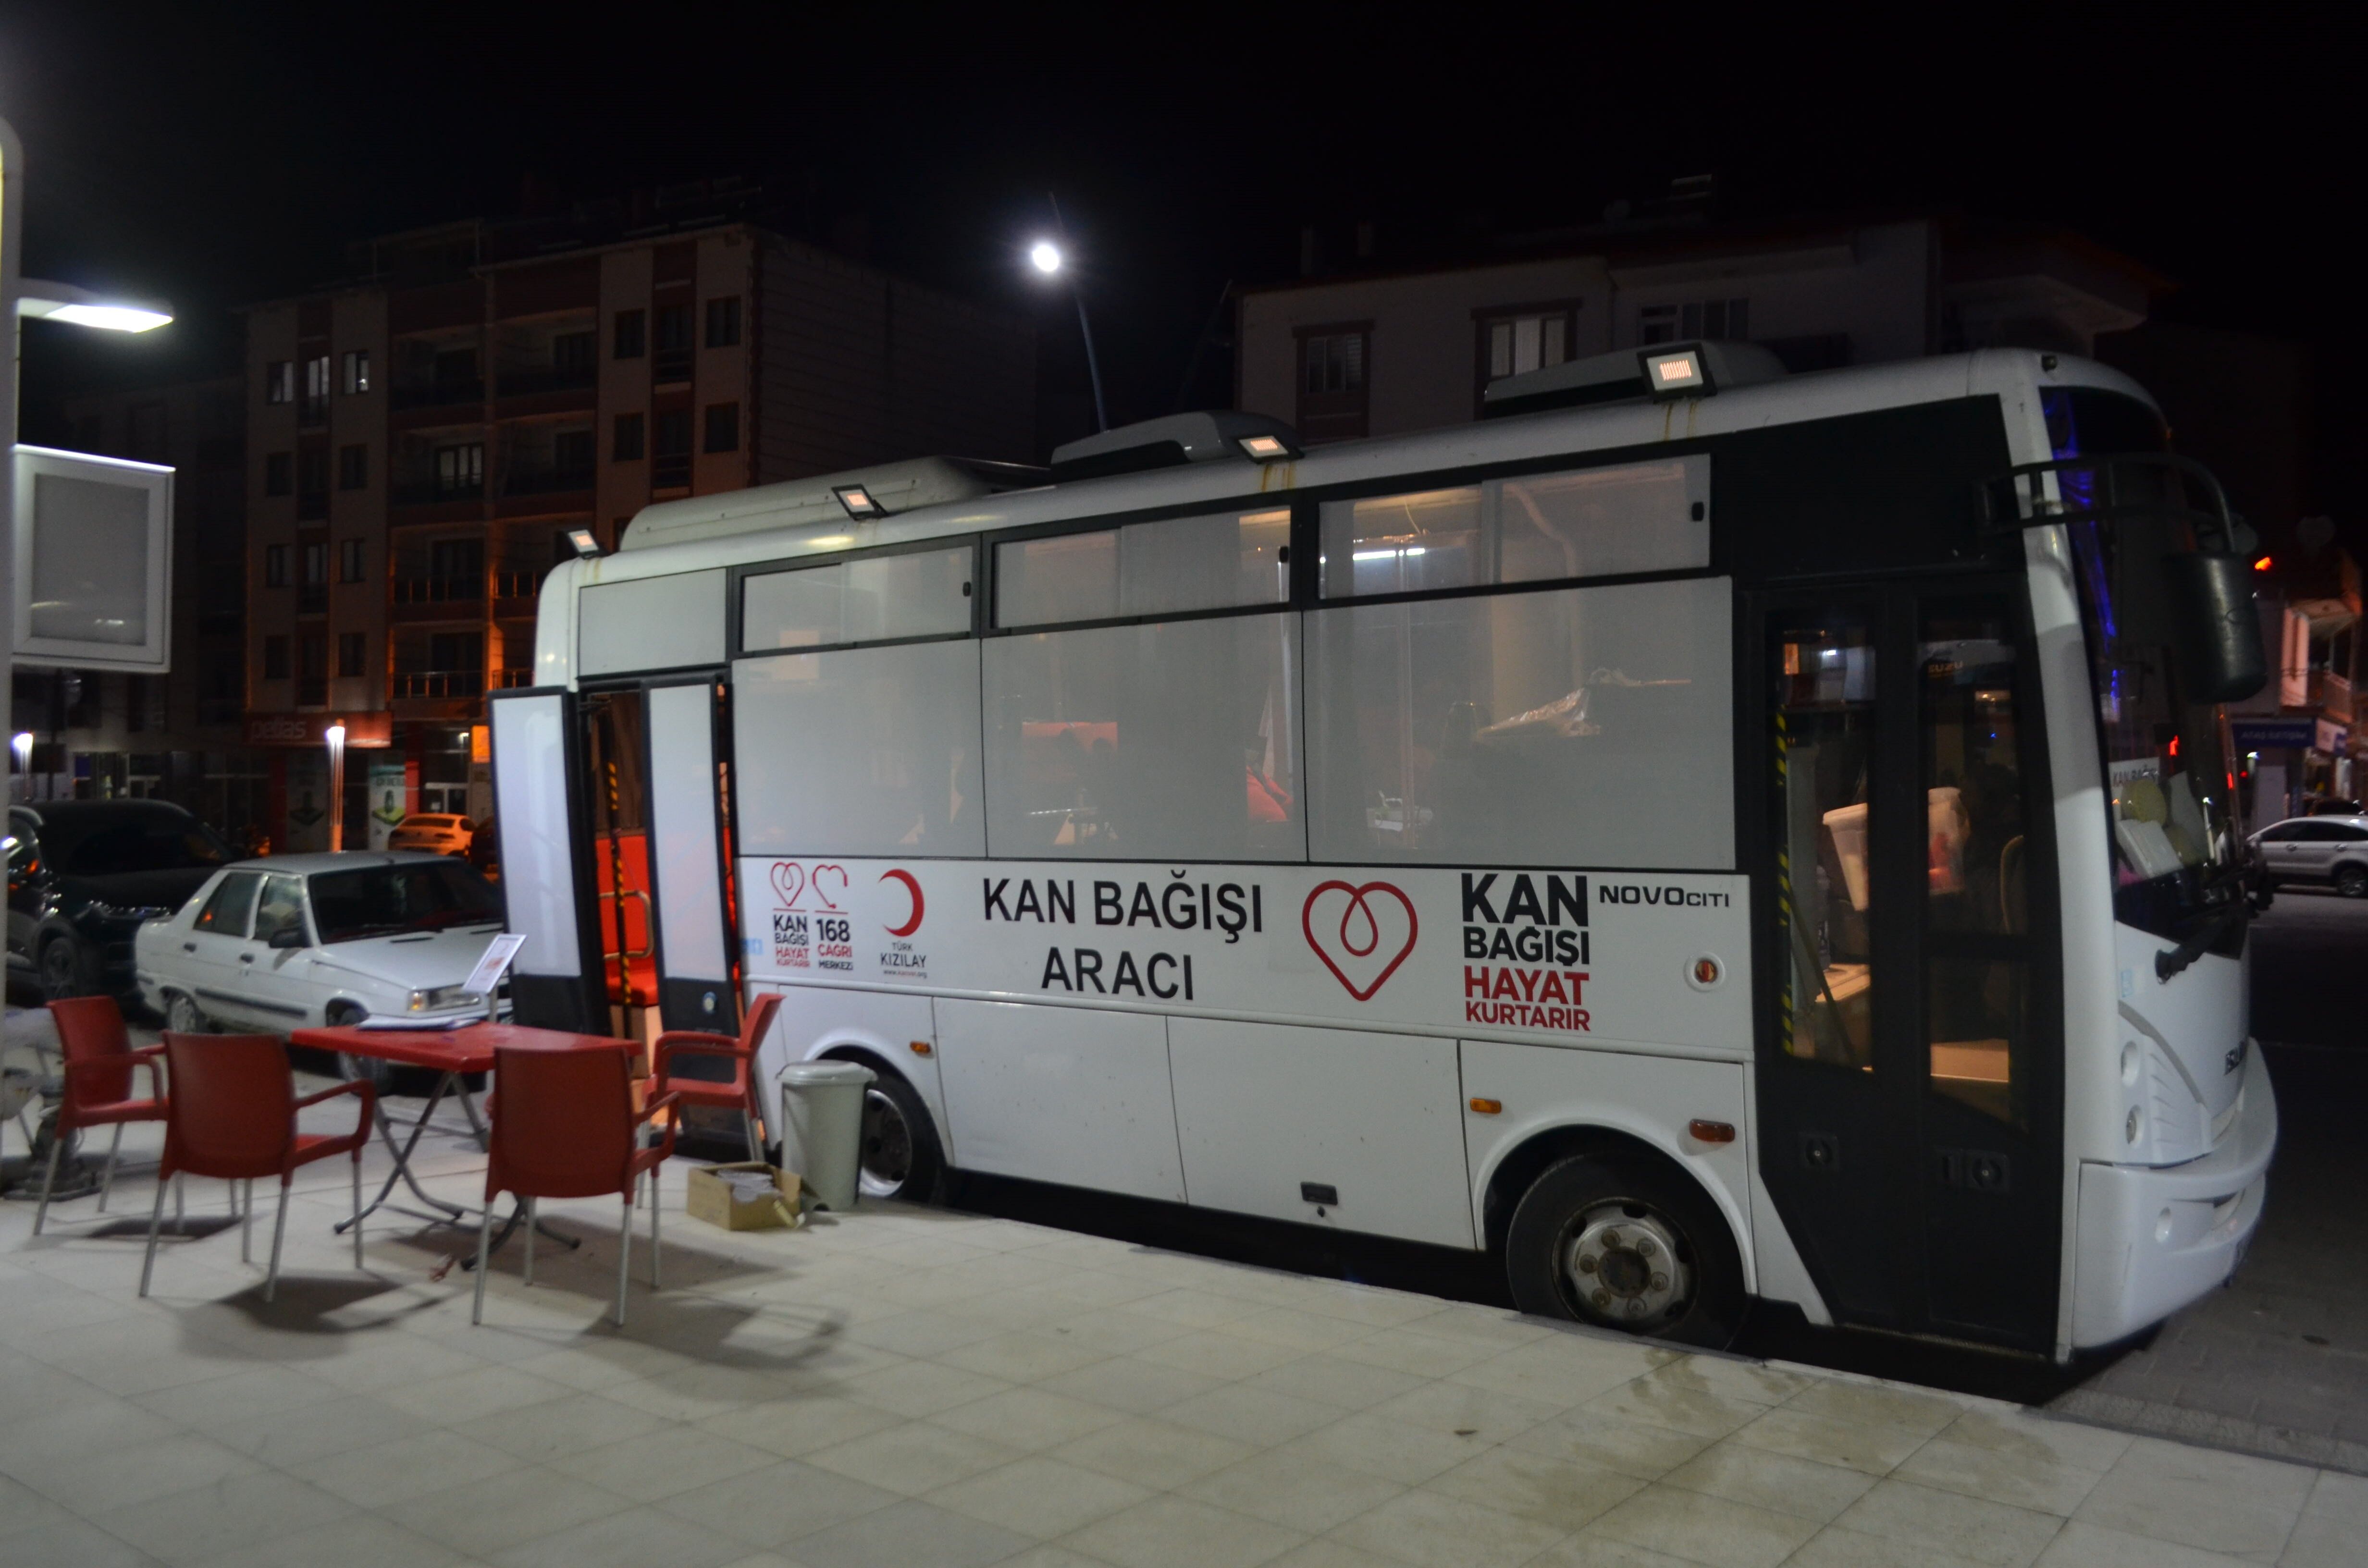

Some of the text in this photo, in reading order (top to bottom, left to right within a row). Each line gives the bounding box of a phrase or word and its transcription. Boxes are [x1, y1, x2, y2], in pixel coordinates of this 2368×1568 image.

[983, 869, 1262, 943] KAN BAĞIŞI
[1461, 872, 1589, 927] KAN
[774, 915, 808, 933] KAN
[816, 919, 850, 942] 168
[776, 946, 810, 959] HAYAT
[881, 953, 926, 968] KIZILAY
[892, 941, 913, 951] TÜRK
[1463, 926, 1590, 966] BAĞIŞI
[1041, 946, 1194, 1000] ARACI
[1464, 965, 1590, 1005] HAYAT
[1466, 1001, 1590, 1031] KURTARIR
